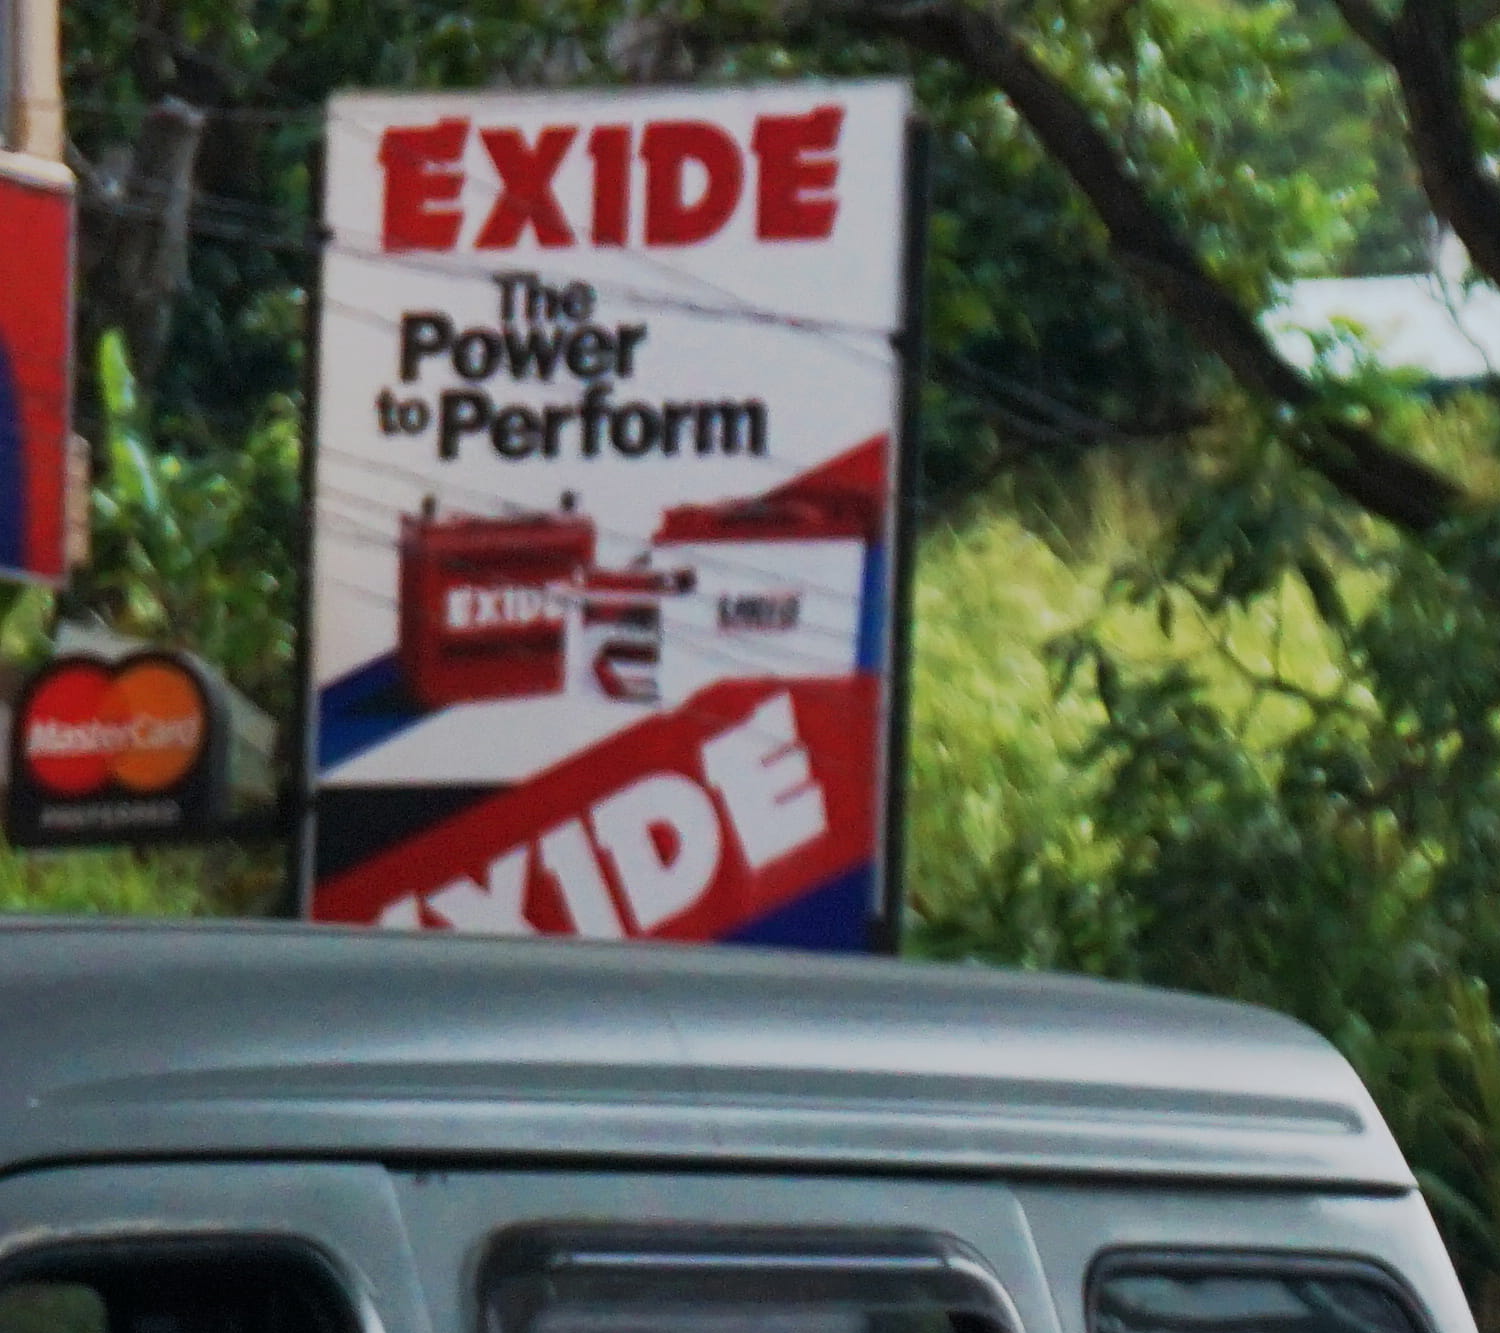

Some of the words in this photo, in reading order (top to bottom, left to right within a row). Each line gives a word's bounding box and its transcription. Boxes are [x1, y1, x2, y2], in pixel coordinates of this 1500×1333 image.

[378, 104, 846, 254] EXIDE
[494, 272, 596, 322] The
[400, 312, 648, 384] Power
[376, 388, 430, 436] to
[436, 380, 766, 460] Perform
[378, 690, 828, 942] XIDE
